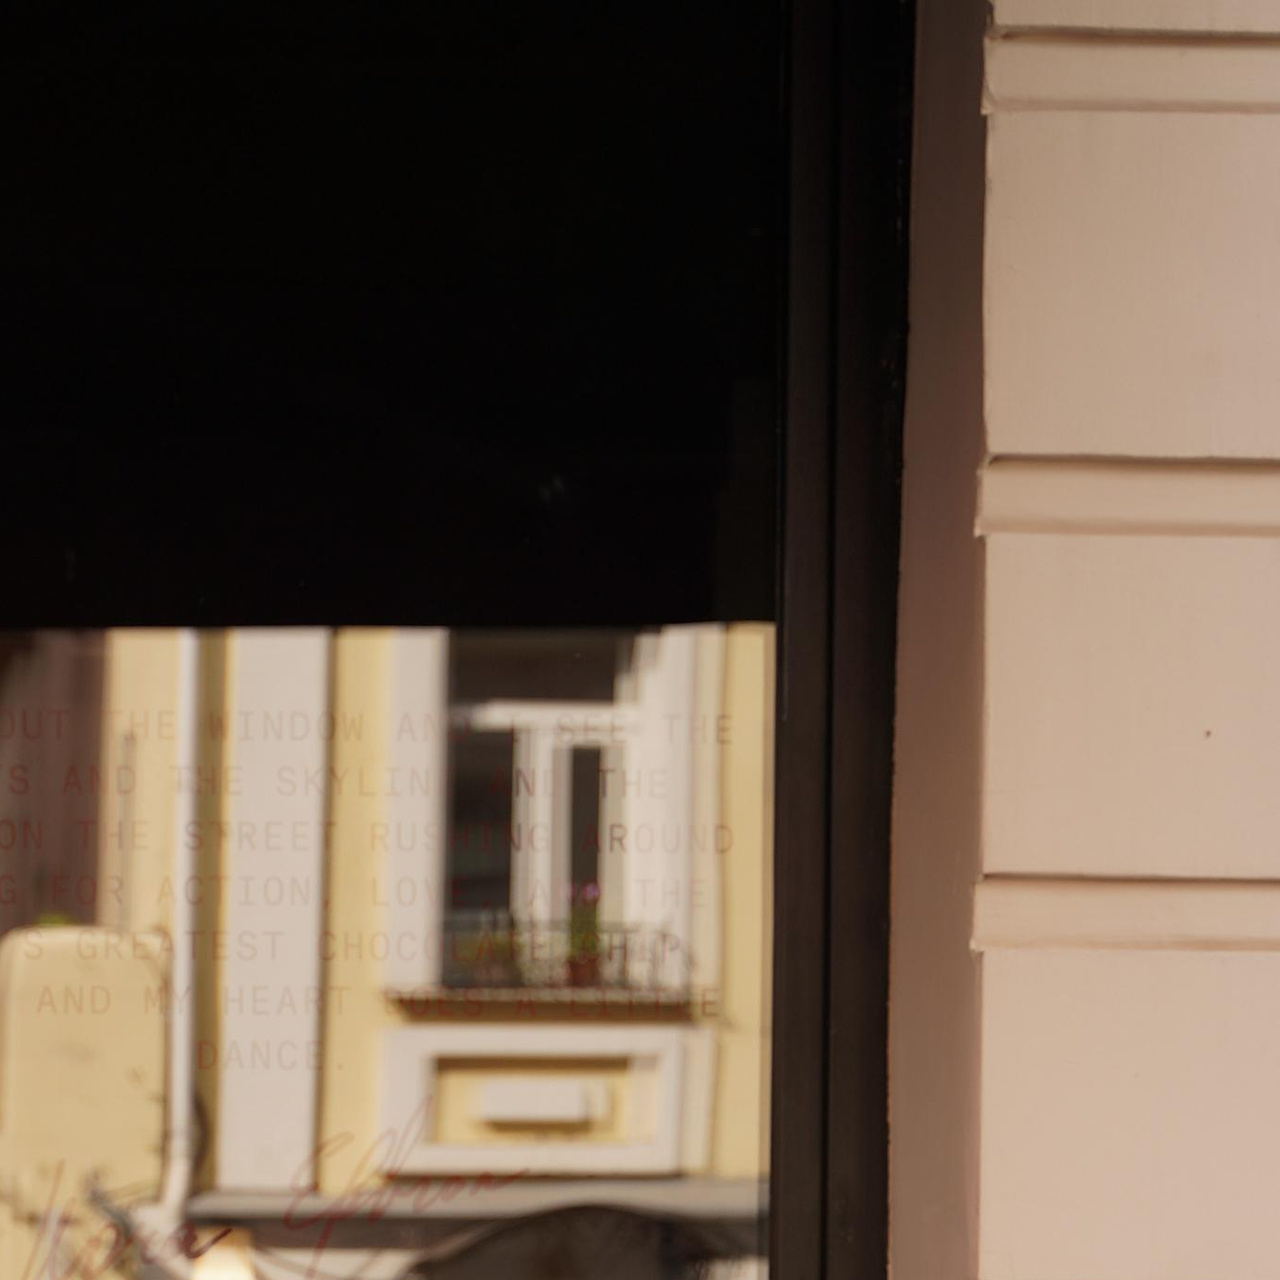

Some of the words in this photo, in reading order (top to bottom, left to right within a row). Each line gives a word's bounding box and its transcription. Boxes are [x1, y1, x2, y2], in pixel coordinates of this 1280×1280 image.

[102, 710, 175, 741] THE
[206, 711, 365, 743] WINDOW
[663, 714, 733, 744] THE
[64, 765, 136, 795] AND
[169, 766, 244, 796] THE
[597, 768, 669, 798] THE
[76, 820, 150, 850] THE
[184, 821, 337, 851] STREET
[370, 823, 549, 853] RUSHING
[581, 824, 734, 854] AROUND
[51, 874, 123, 905] FOR
[634, 879, 708, 909] THE
[76, 930, 283, 961] GREATEST
[317, 931, 554, 961] CHOCOLATE
[36, 985, 112, 1015] AND
[143, 986, 193, 1015] MY
[226, 986, 352, 1016] HEART
